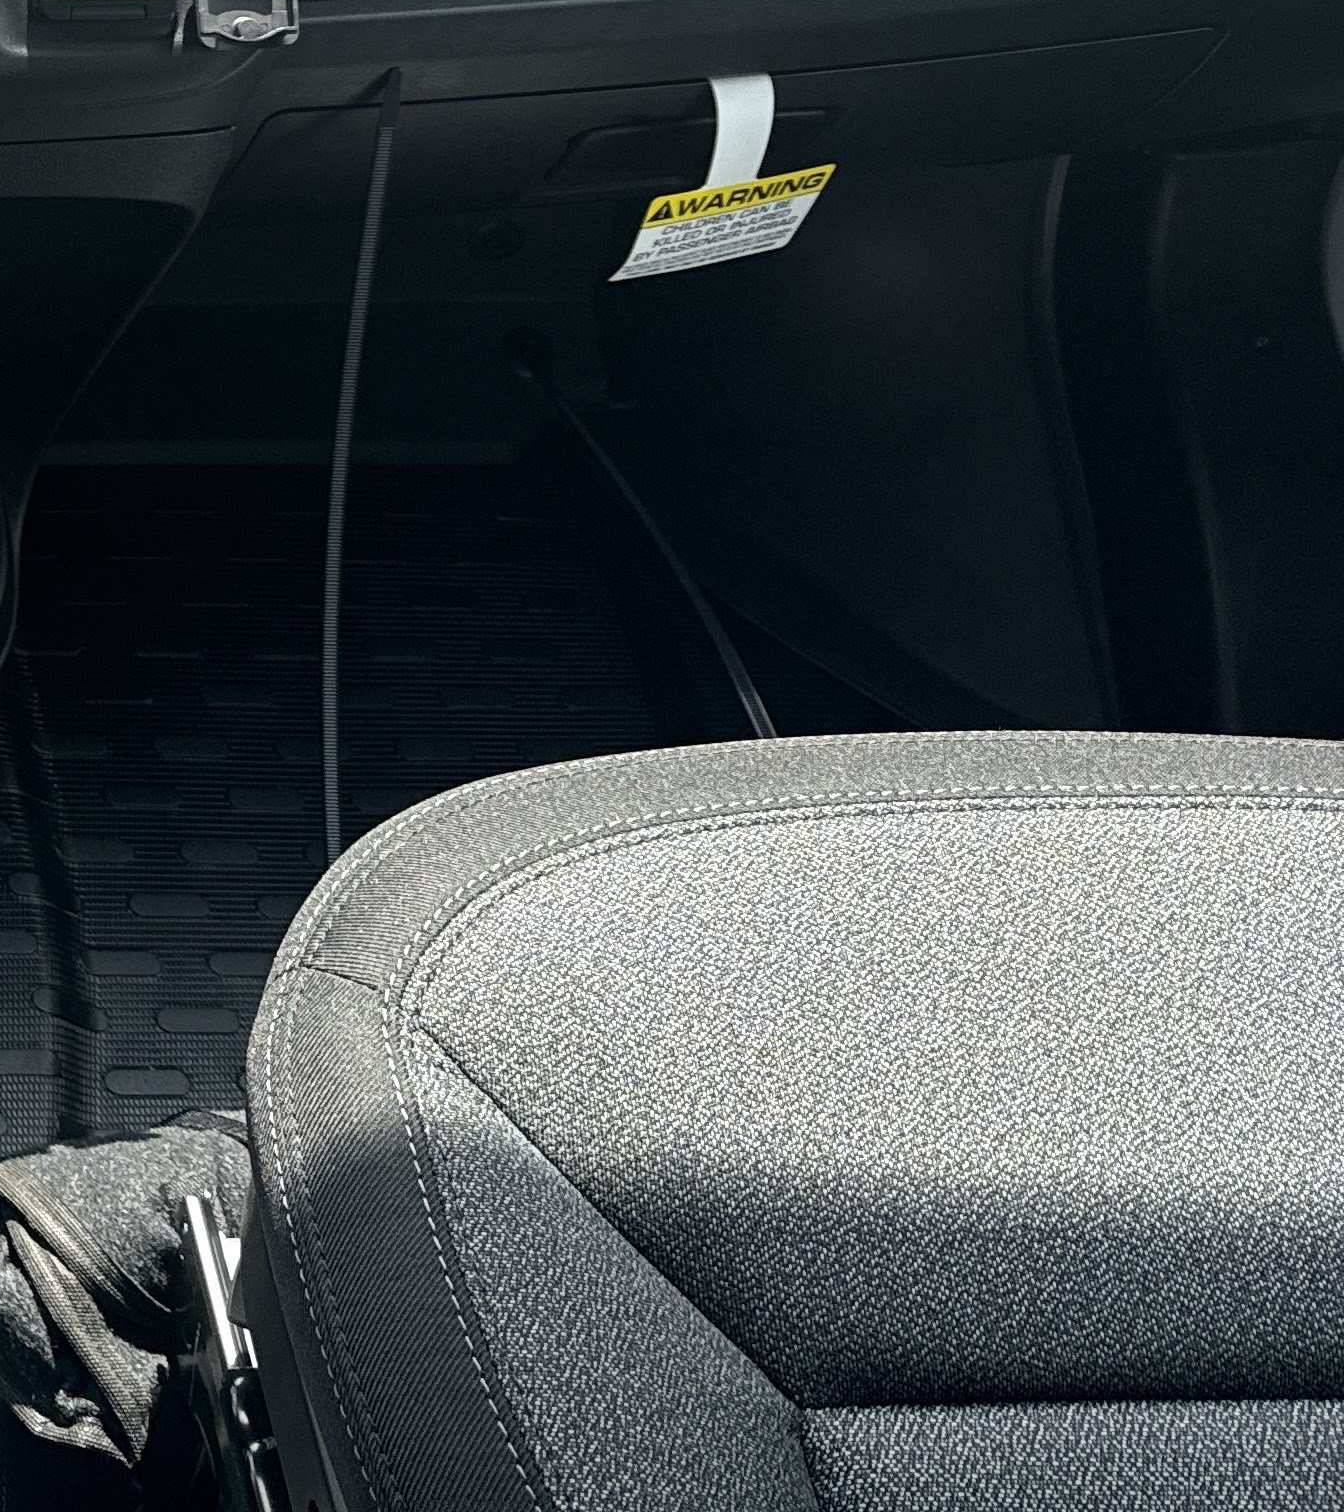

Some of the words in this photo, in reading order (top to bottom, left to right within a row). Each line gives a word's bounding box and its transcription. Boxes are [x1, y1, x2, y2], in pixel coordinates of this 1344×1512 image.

[677, 172, 826, 215] WARNING
[652, 230, 702, 248] KILLED
[704, 224, 724, 237] OR
[728, 209, 792, 231] INJURED
[661, 212, 736, 235] CHILDREN
[738, 204, 771, 220] CAN
[773, 199, 793, 211] BE
[633, 251, 652, 263] BY
[657, 229, 743, 257] PASSENGER
[744, 216, 799, 235] AIRBAG
